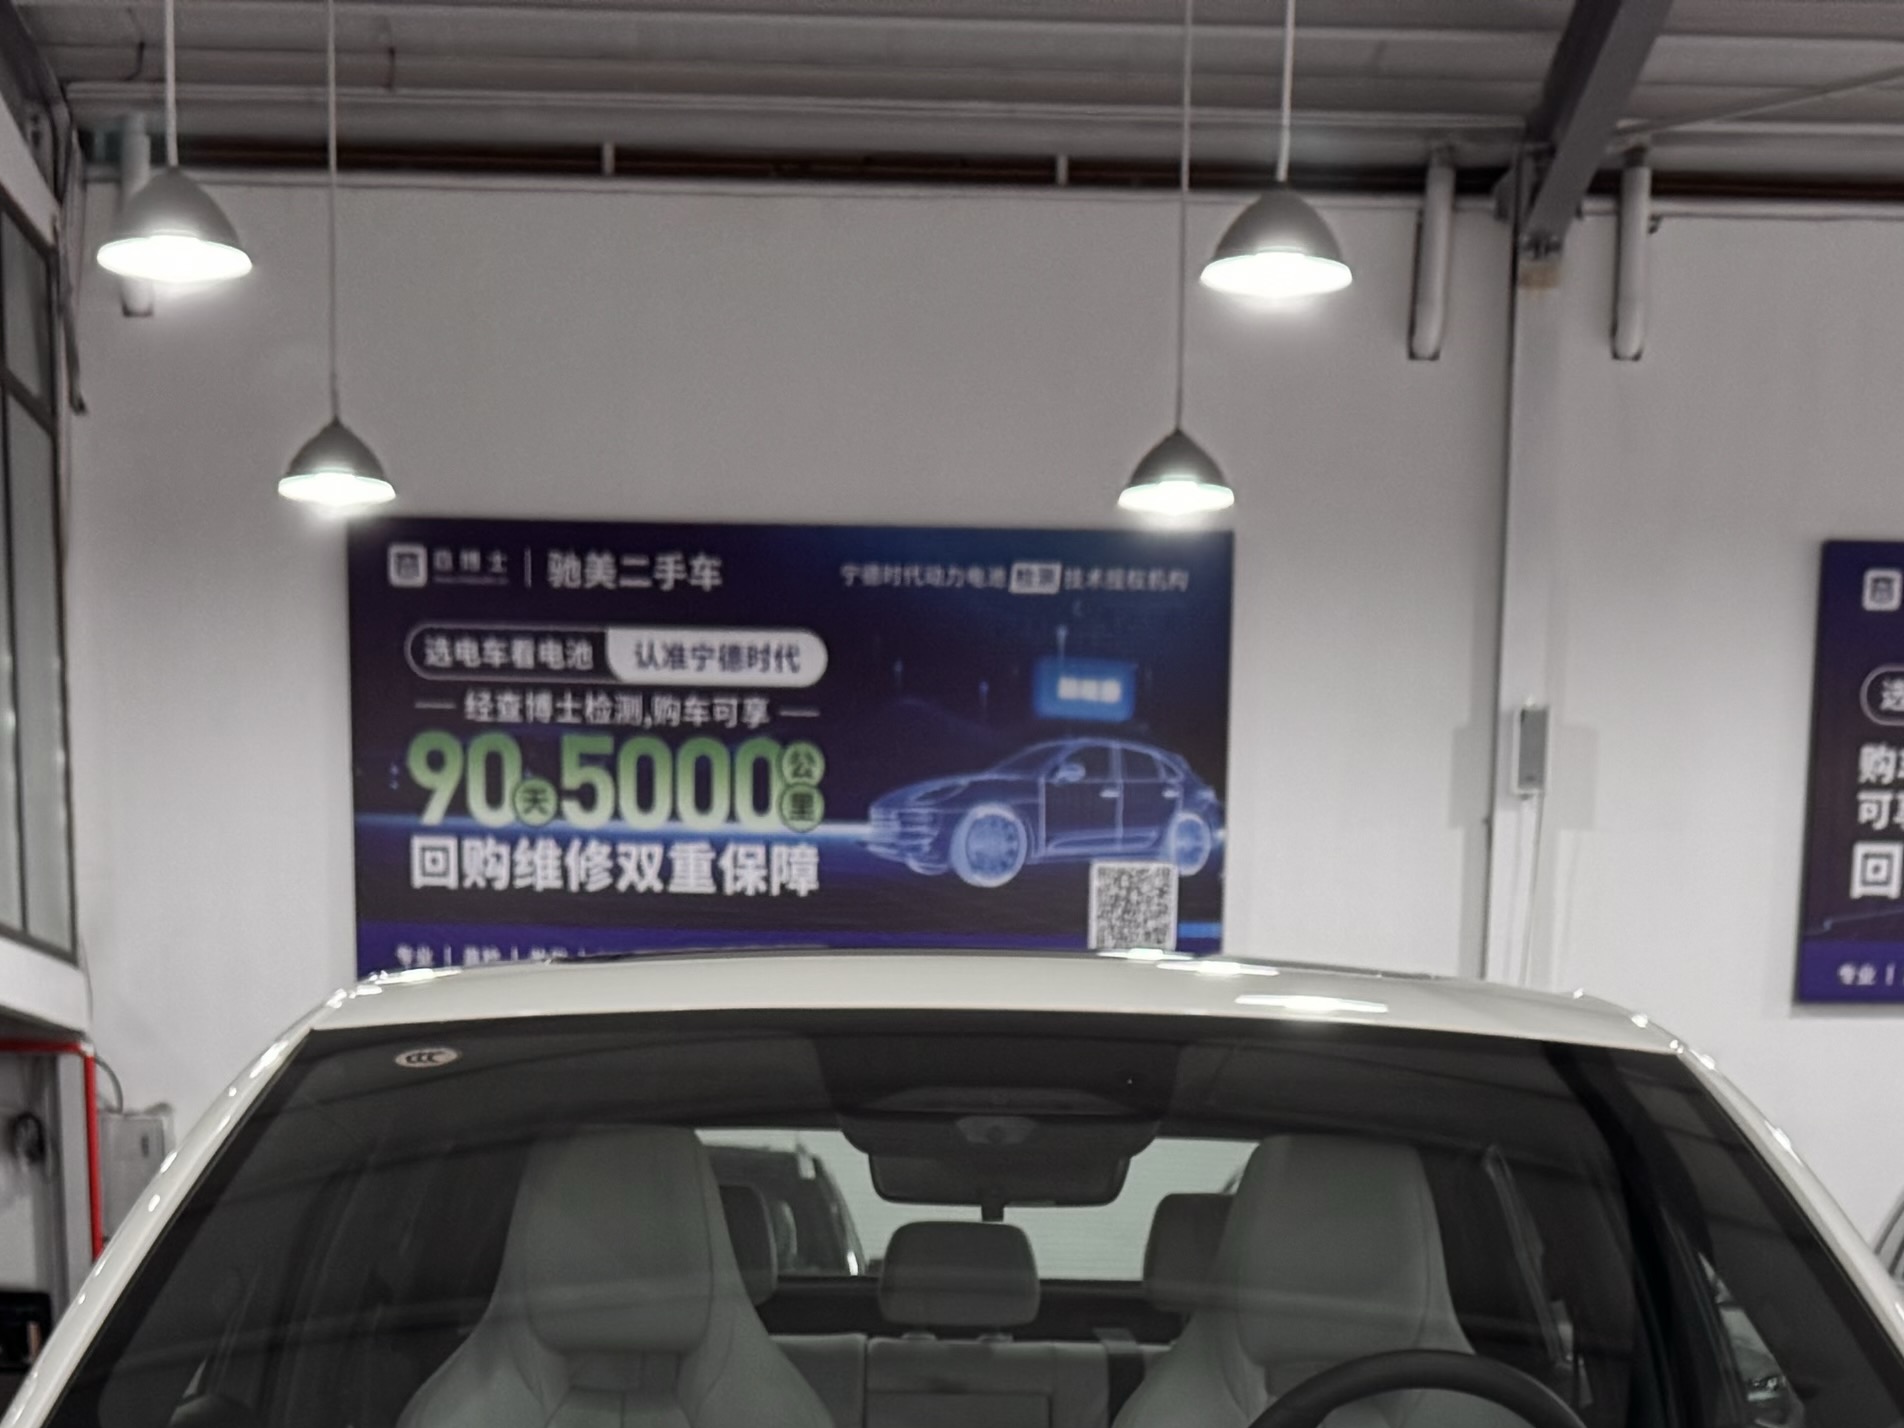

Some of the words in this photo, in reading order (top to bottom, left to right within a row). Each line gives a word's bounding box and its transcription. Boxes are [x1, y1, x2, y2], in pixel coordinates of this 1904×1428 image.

[547, 550, 723, 591] 驰美二手车
[424, 635, 594, 671] 选电车看电池
[634, 640, 801, 673] 认准宁德时代
[410, 834, 821, 897] 回购维修双重保障
